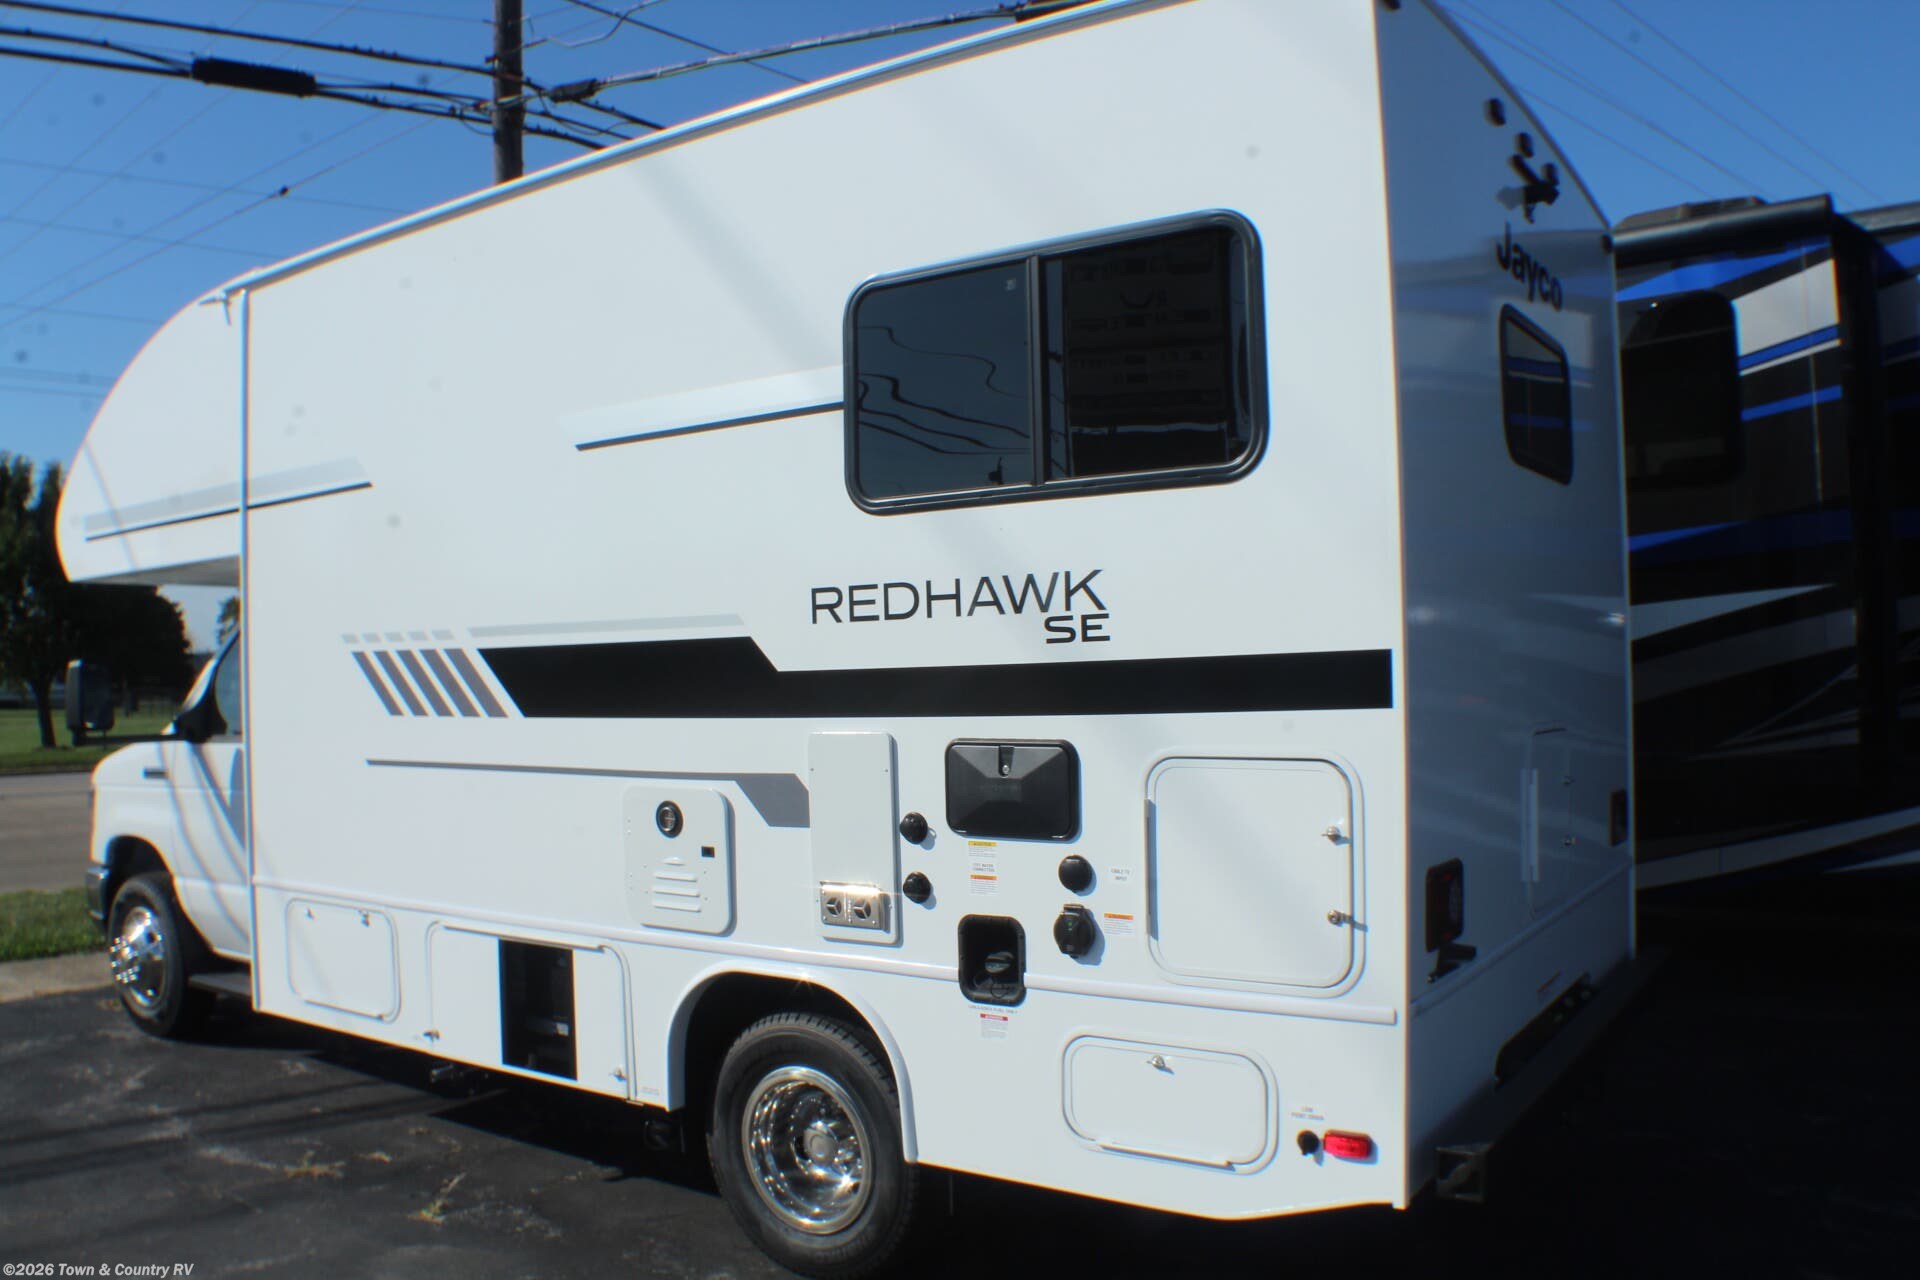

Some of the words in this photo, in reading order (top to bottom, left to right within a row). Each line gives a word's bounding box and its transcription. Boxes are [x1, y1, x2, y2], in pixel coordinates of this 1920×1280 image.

[1496, 220, 1563, 312] Jayco
[811, 569, 1107, 624] REDHAWK
[1044, 613, 1111, 644] SE
